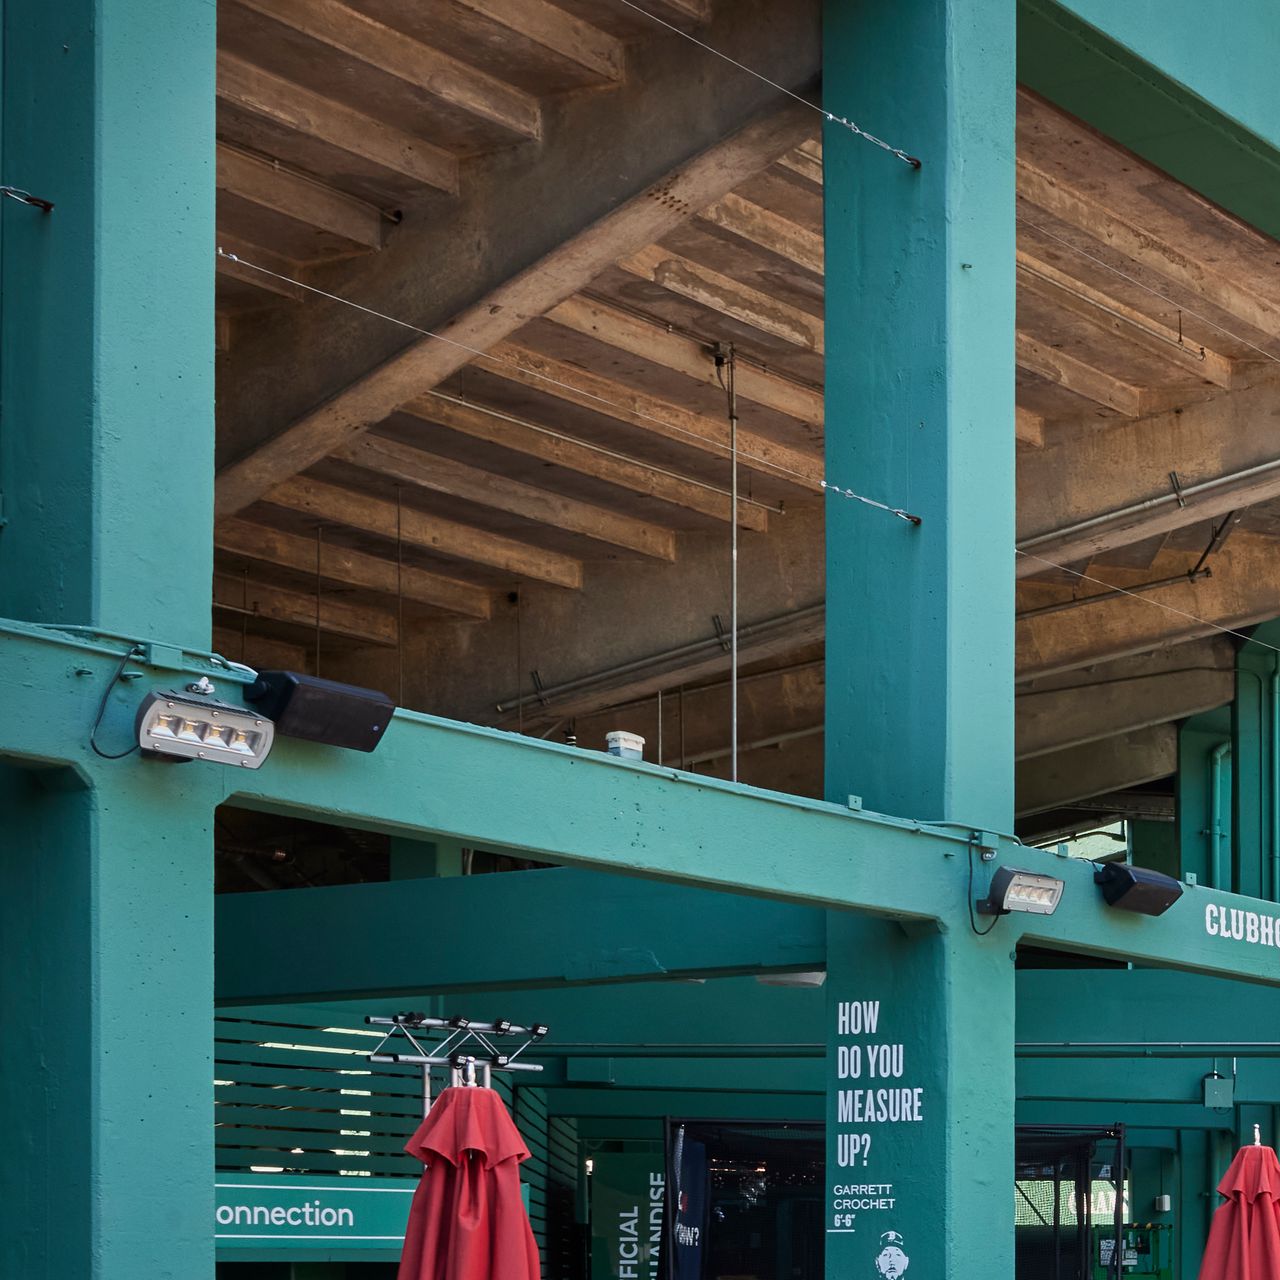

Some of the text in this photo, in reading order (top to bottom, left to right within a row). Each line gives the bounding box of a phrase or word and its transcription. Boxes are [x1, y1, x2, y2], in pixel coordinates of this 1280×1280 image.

[838, 1001, 879, 1034] HOW
[838, 1044, 903, 1078] DO YOU
[838, 1087, 923, 1122] MEASURE
[837, 1133, 871, 1167] UP?
[833, 1184, 893, 1195] GARRETT
[833, 1198, 895, 1209] CROCHET
[216, 1200, 354, 1226] onnection
